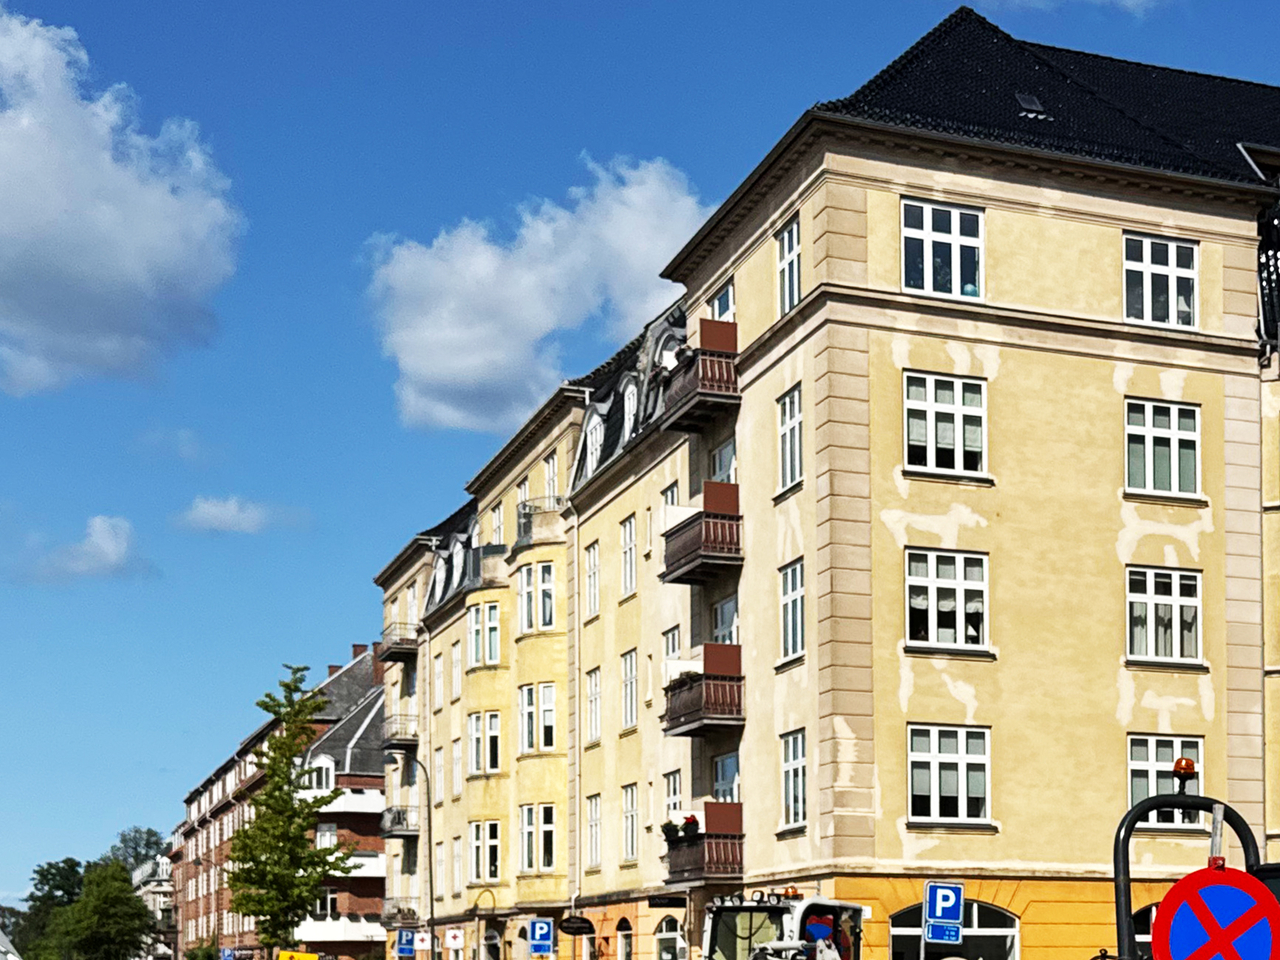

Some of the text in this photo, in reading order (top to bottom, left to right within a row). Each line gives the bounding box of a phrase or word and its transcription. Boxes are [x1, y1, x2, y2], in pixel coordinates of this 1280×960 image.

[935, 888, 956, 917] P
[401, 931, 413, 944] P
[535, 922, 549, 940] P
